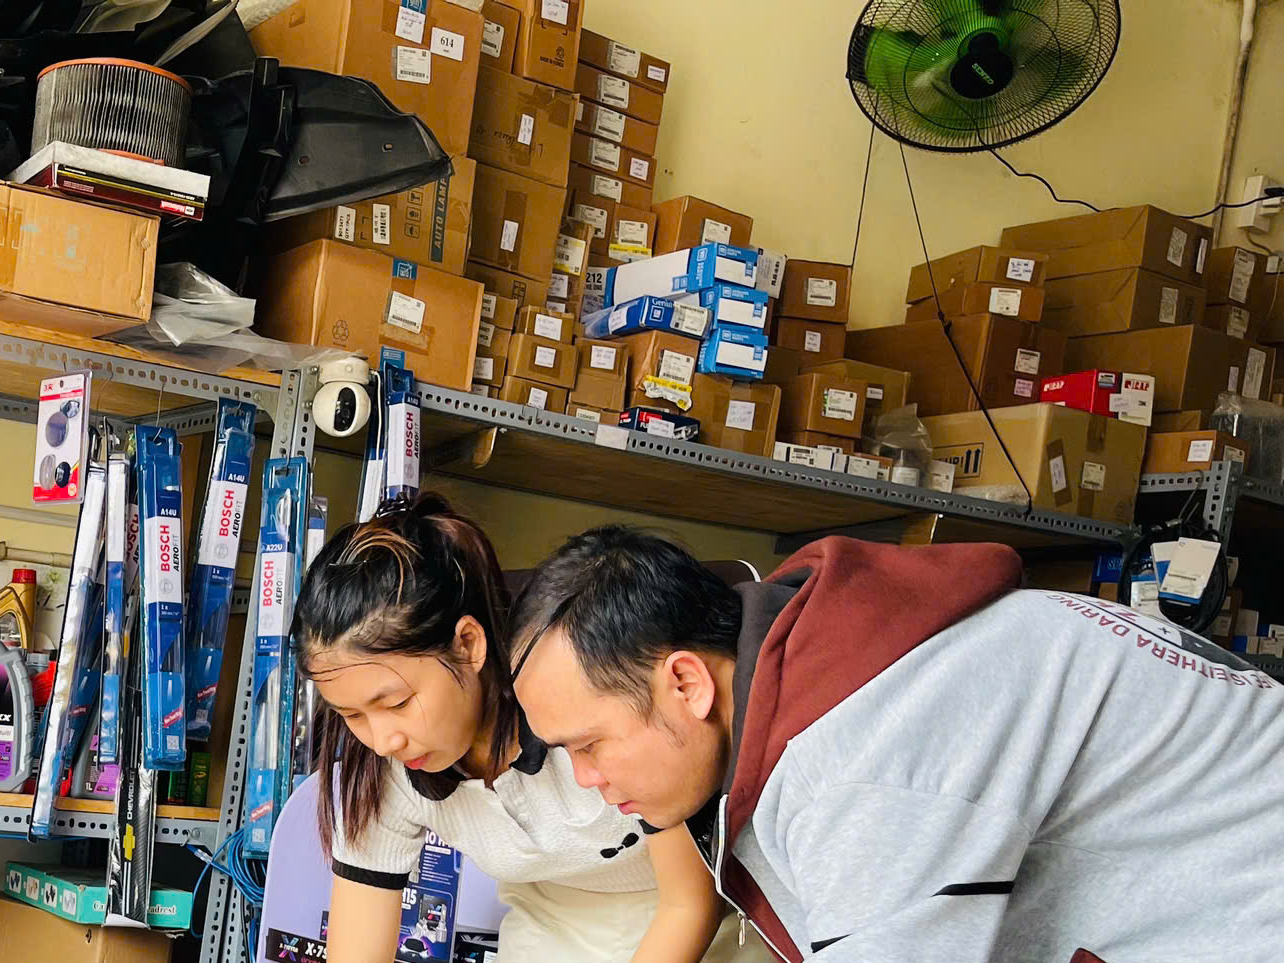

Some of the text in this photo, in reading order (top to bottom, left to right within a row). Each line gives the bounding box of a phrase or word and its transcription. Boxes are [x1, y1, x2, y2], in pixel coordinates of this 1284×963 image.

[440, 36, 454, 48] 614
[433, 216, 445, 249] AUTO
[219, 489, 234, 537] BOSCH
[232, 500, 243, 538] AEROFIT
[160, 525, 170, 572] BOSCH
[172, 534, 180, 572] AEROFIT
[262, 560, 274, 607] BOSCH
[1136, 633, 1152, 648] A
[1151, 642, 1228, 681] EITHER
[127, 771, 135, 820] CHEVROLET
